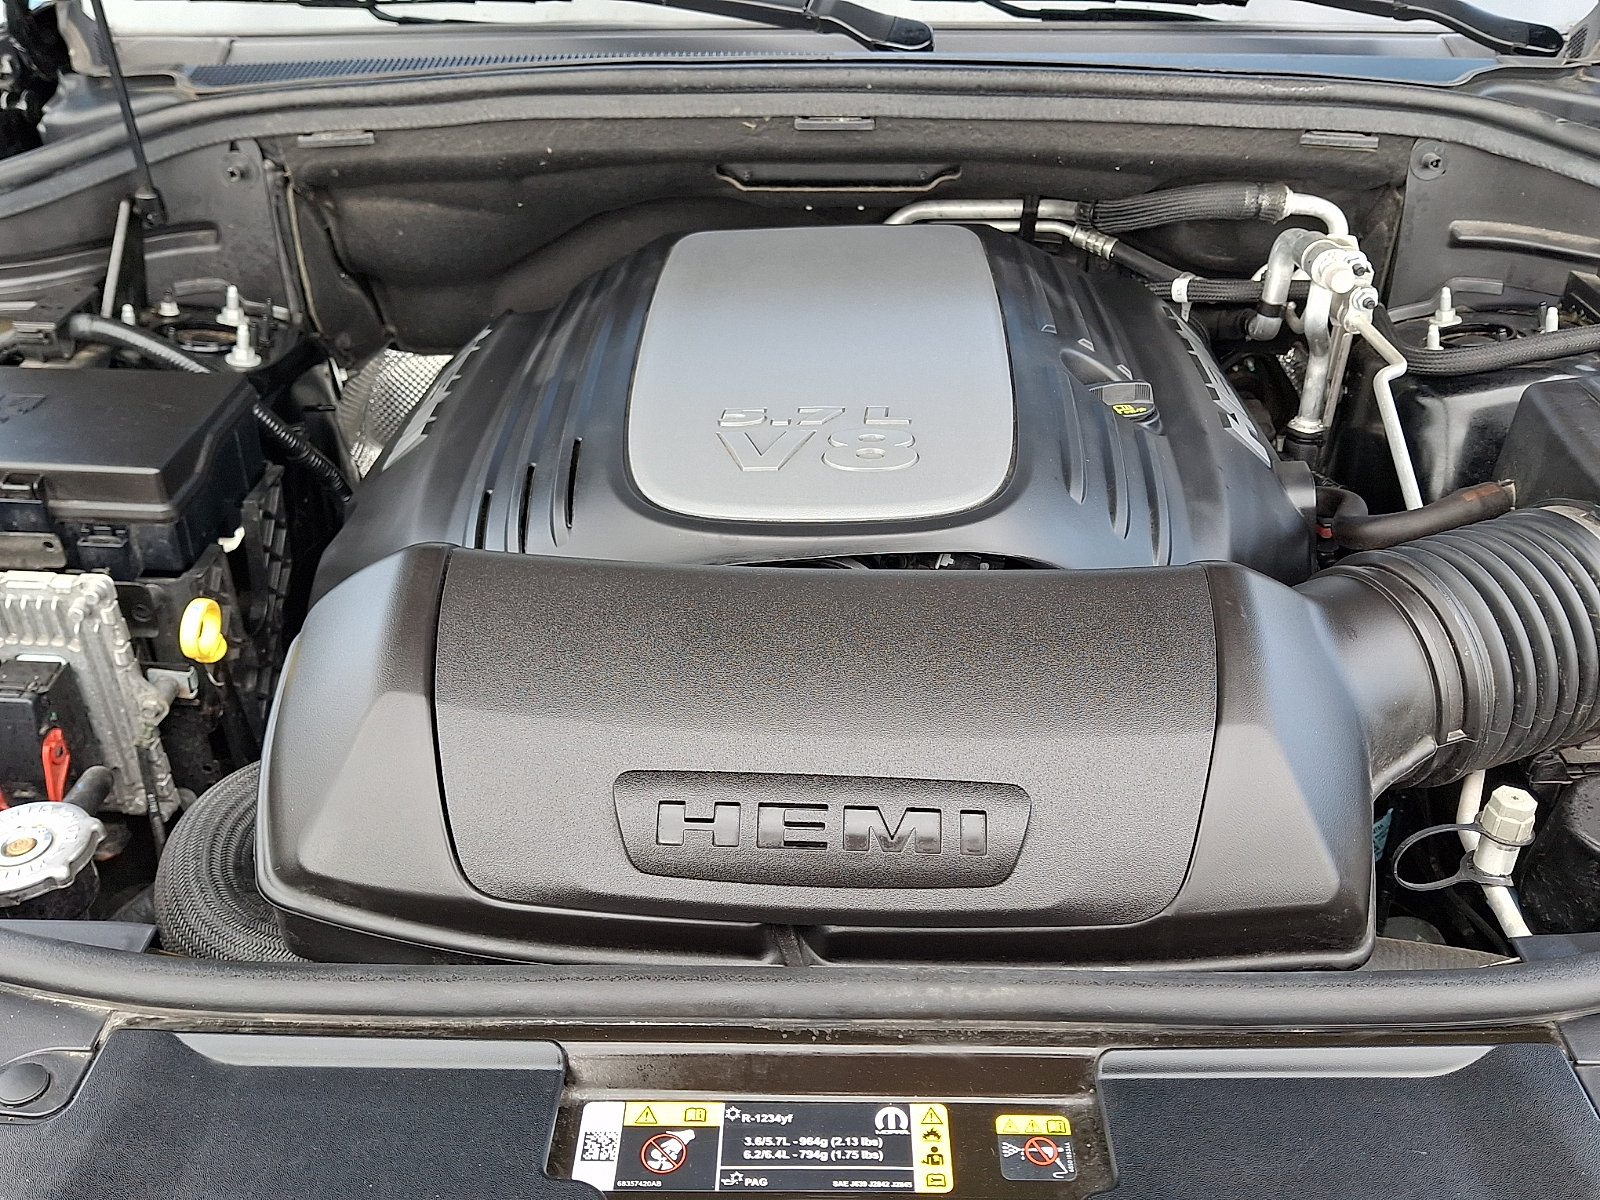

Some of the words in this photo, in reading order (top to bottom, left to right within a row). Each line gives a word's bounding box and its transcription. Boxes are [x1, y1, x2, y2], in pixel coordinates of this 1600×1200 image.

[717, 406, 846, 427] 5.7
[715, 428, 921, 472] V8
[656, 801, 988, 857] HEMI
[741, 1113, 794, 1126] R-1234yf
[743, 1136, 791, 1147] 3.6/5.7L
[798, 1136, 829, 1148] 964g
[830, 1136, 859, 1149] (2.13
[860, 1136, 883, 1149] lbs)
[742, 1149, 791, 1160] 6.2/6.4L
[798, 1149, 829, 1162] 794g
[830, 1149, 859, 1162] (1.75
[860, 1149, 884, 1162] lbs)
[744, 1177, 769, 1187] PAG
